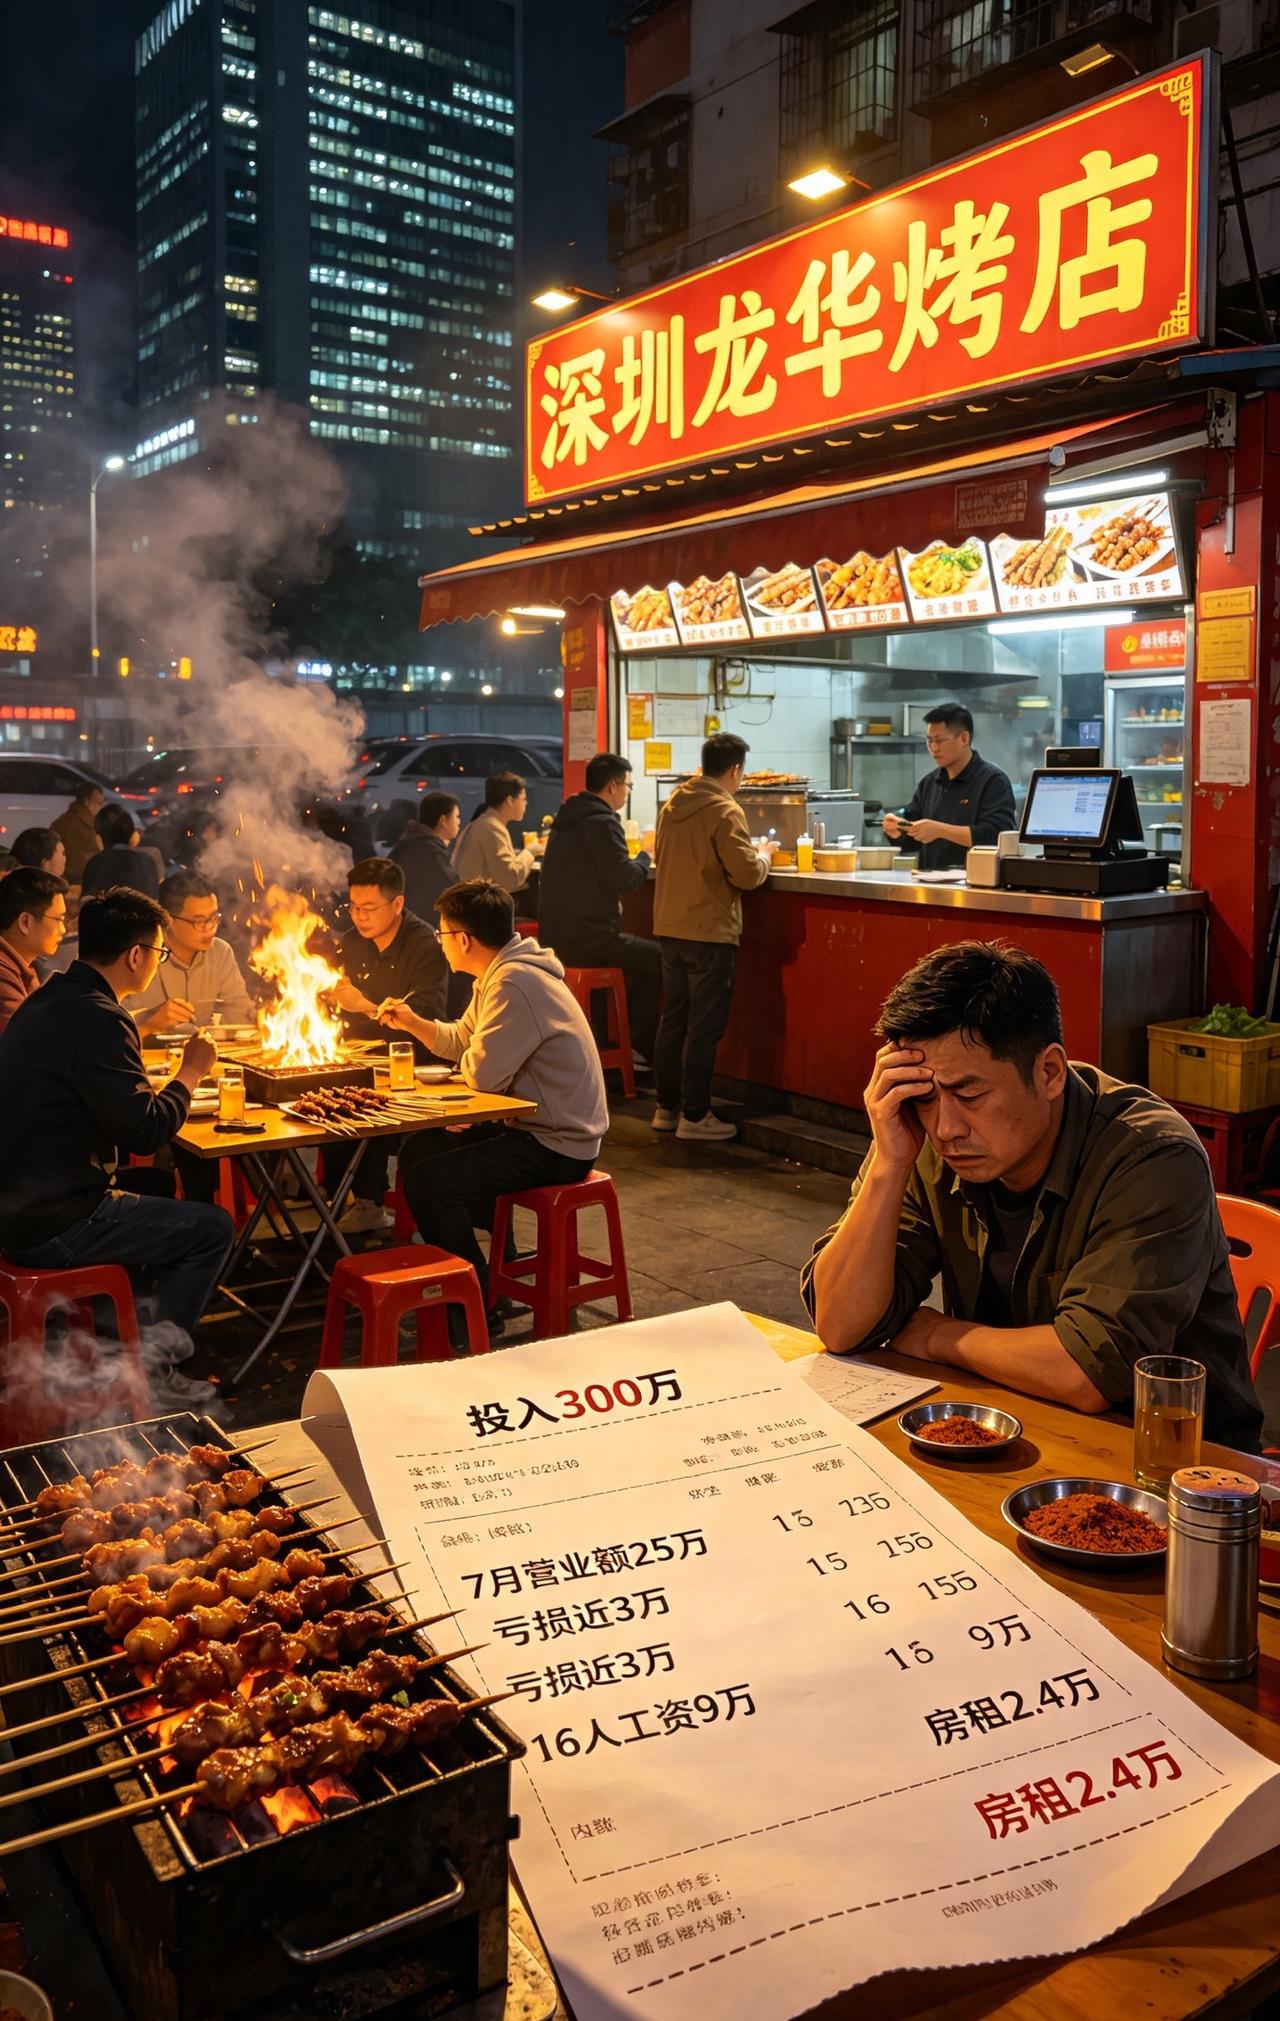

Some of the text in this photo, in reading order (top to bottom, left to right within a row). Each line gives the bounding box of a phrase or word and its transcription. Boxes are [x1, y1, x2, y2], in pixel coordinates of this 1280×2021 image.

[541, 150, 1158, 469] 深圳龙华烤店
[466, 1369, 681, 1437] 投入300万
[461, 1529, 707, 1599] 7月营业额25万
[493, 1587, 669, 1646] 亏损近3万
[807, 1552, 847, 1575] 15
[505, 1643, 674, 1704] 亏损近3万
[844, 1594, 890, 1619] 16
[530, 1684, 755, 1762] 16人工资9万
[968, 1614, 1031, 1649] 9万
[924, 1668, 1099, 1746] 房租2.4万
[974, 1740, 1182, 1839] 房租2.4万
